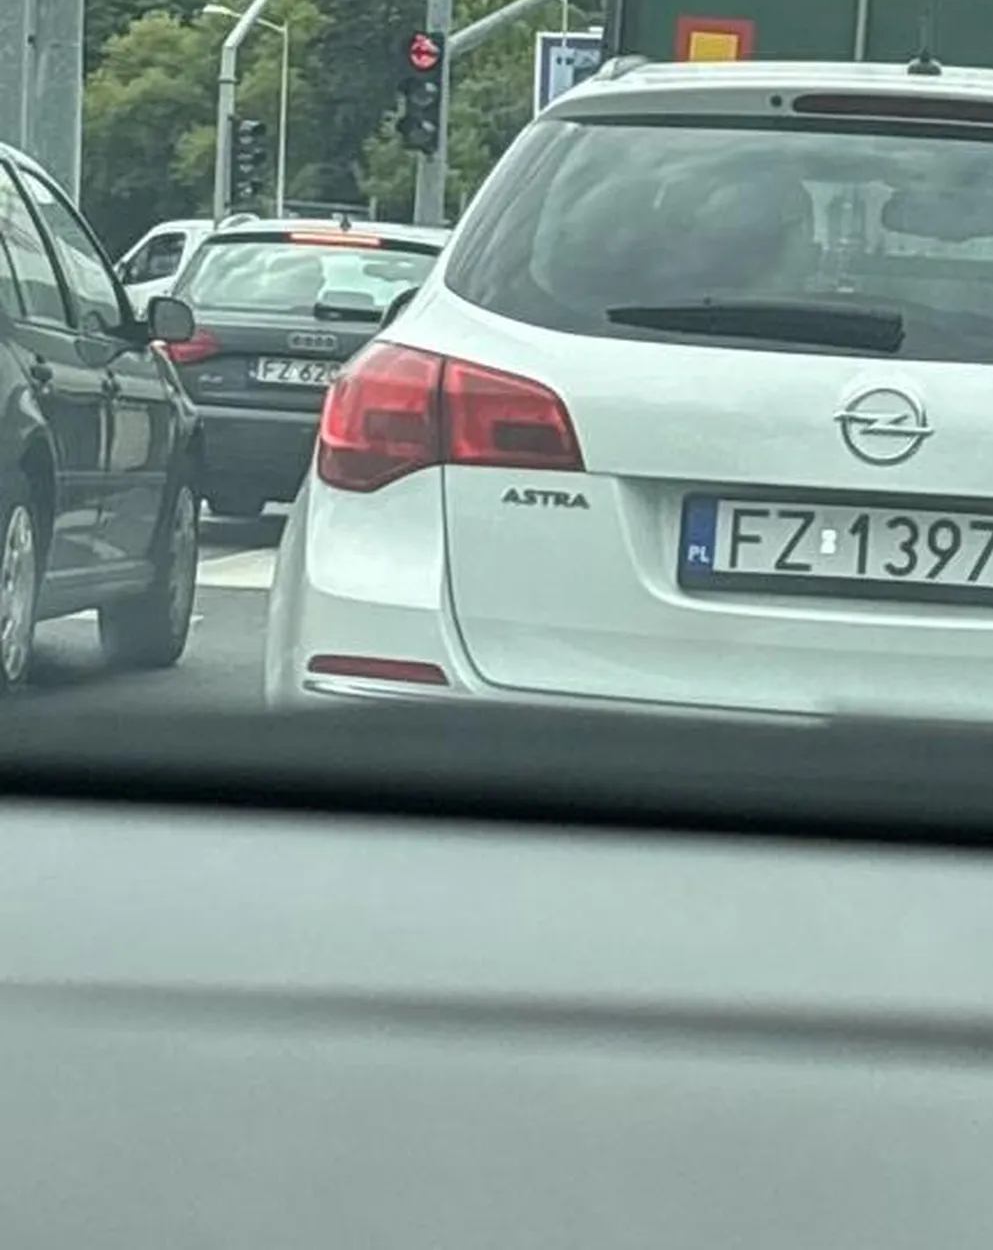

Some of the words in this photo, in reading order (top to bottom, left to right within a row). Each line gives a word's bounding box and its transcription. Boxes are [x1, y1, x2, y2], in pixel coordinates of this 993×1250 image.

[501, 487, 591, 510] ASTRA
[686, 544, 711, 564] PL
[728, 507, 816, 573] FZ
